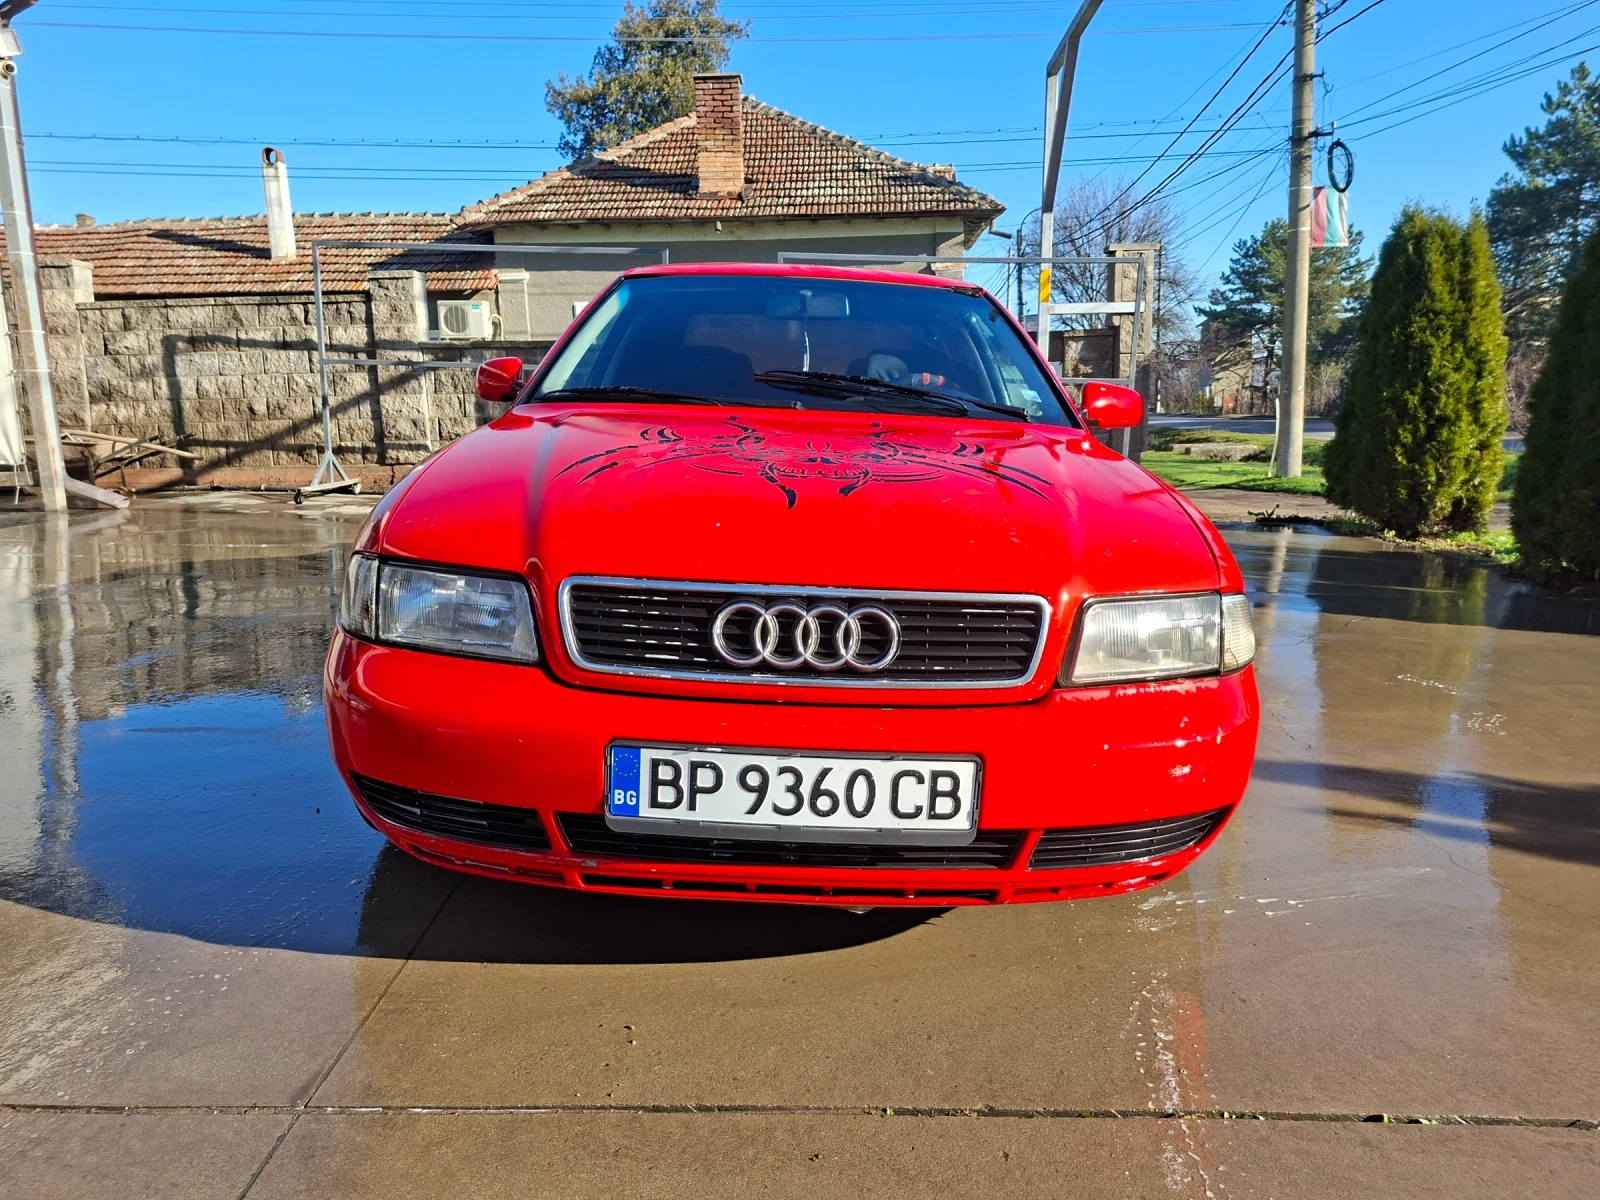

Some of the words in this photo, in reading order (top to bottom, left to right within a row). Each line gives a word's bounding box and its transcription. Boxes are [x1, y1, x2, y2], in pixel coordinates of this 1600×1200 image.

[614, 789, 637, 805] BG
[649, 757, 723, 812] BP
[738, 763, 876, 818] 9360
[890, 769, 962, 820] CB
